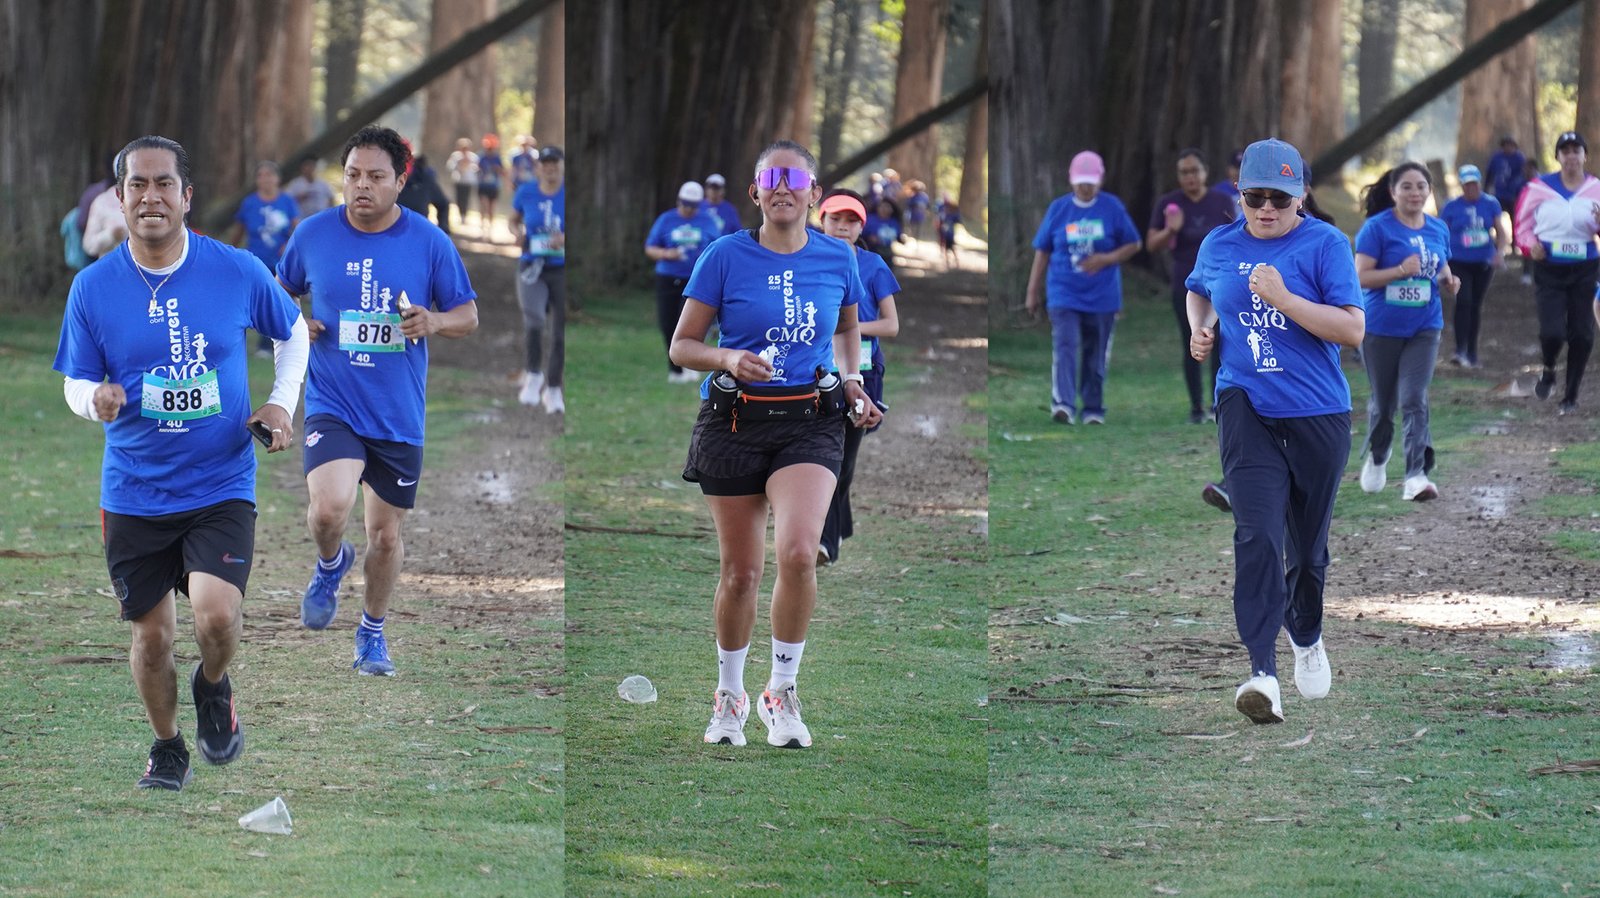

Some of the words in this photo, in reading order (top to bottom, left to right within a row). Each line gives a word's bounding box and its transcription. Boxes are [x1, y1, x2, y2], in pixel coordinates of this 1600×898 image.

[346, 261, 360, 271] 25
[360, 258, 374, 310] carrera
[767, 274, 781, 285] 25
[783, 270, 795, 326] carrera
[1398, 287, 1421, 301] 355
[148, 305, 164, 318] 25
[1238, 311, 1288, 331] CMQ
[166, 297, 182, 363] carrera
[357, 323, 392, 344] 878
[765, 326, 817, 347] CMQ
[182, 325, 191, 362] RECREATIVA
[356, 353, 371, 363] 40
[1262, 357, 1277, 367] 40
[162, 388, 203, 412] 838
